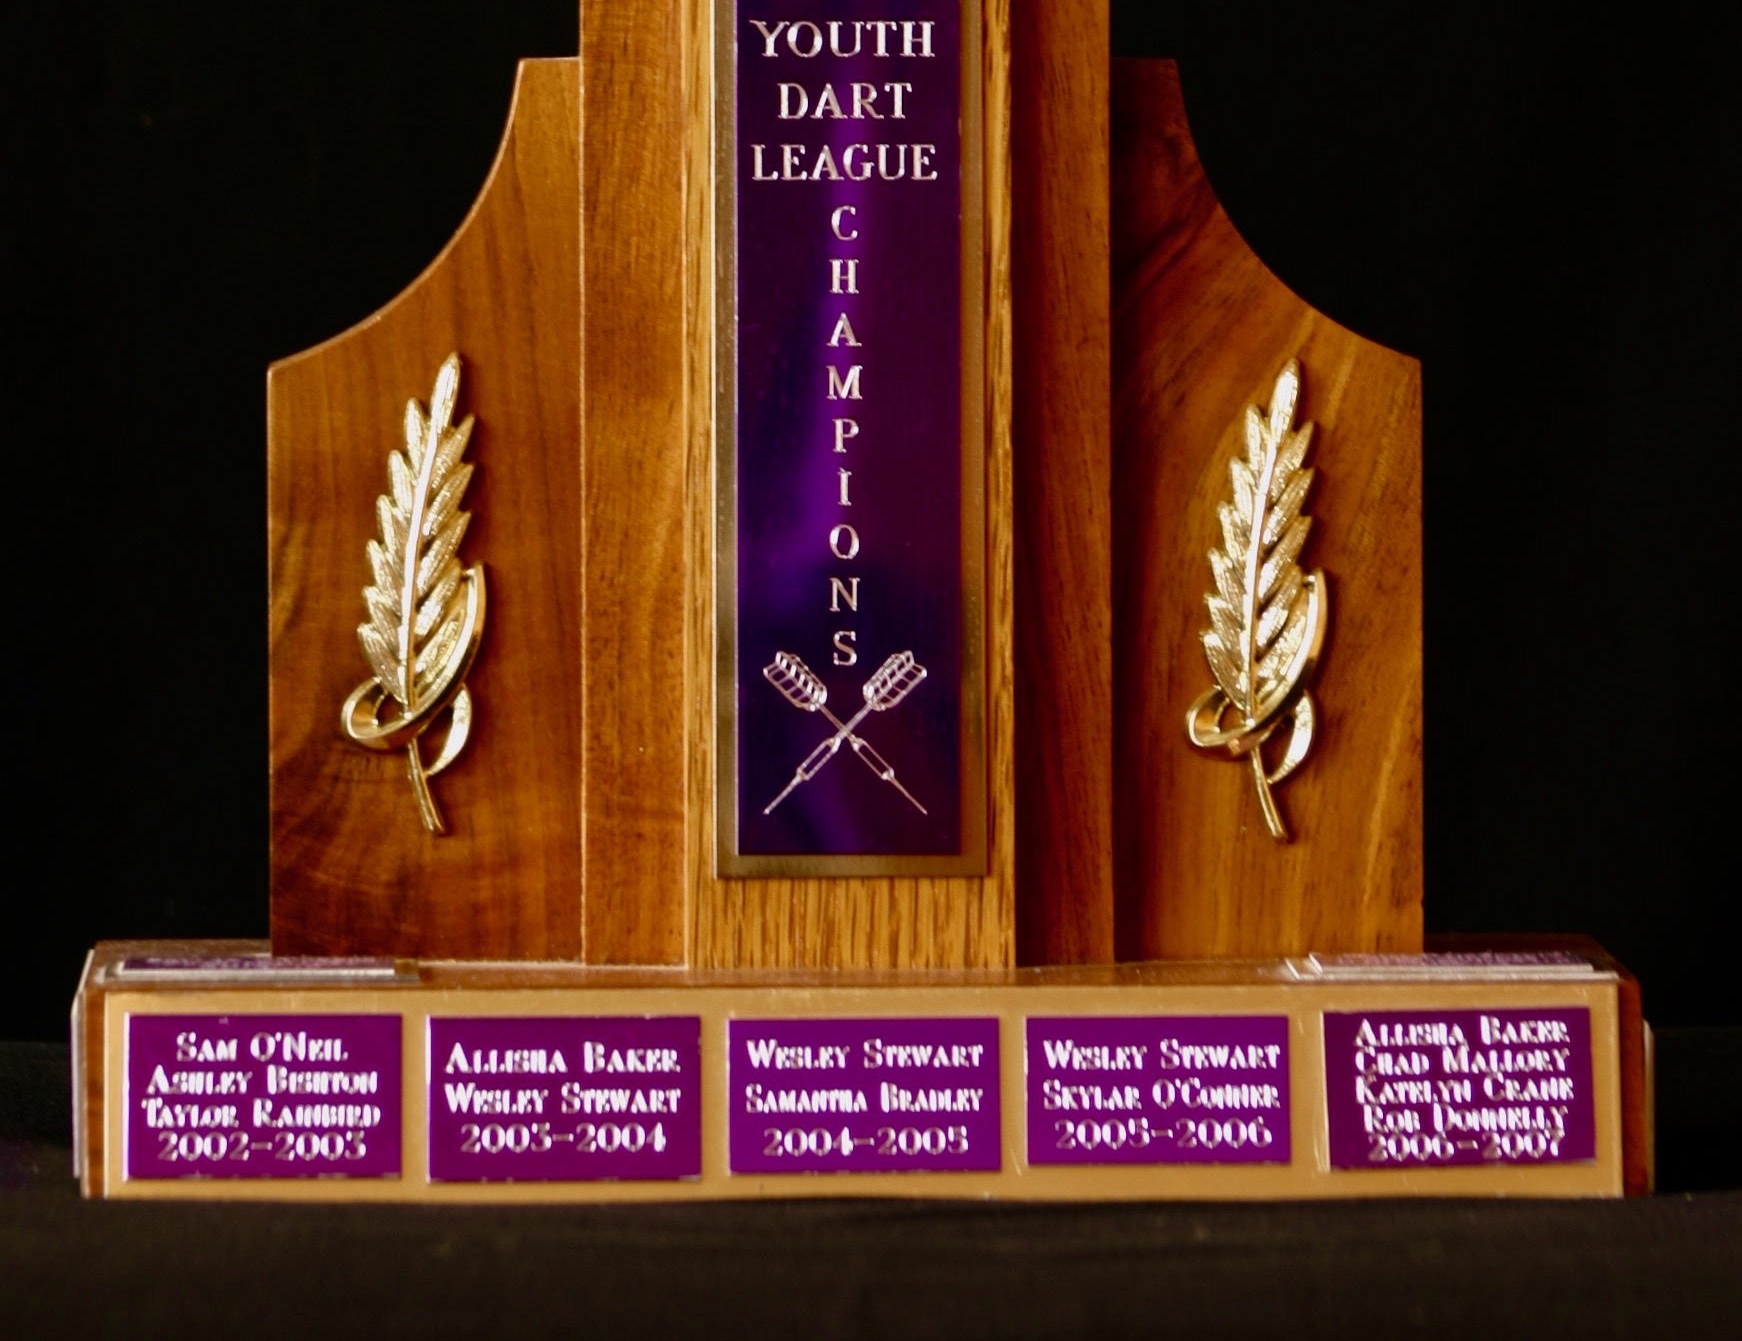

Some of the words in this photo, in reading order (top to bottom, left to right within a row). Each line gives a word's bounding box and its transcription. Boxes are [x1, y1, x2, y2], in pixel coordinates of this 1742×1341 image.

[749, 20, 936, 58] YOUTH
[777, 82, 913, 120] DART
[752, 144, 938, 181] LEAGUE
[157, 1130, 367, 1161] 2002-2003
[460, 1121, 667, 1154] 2003-2004
[763, 1125, 969, 1157] 2004-2005
[1054, 1116, 1272, 1151] 2005-2006
